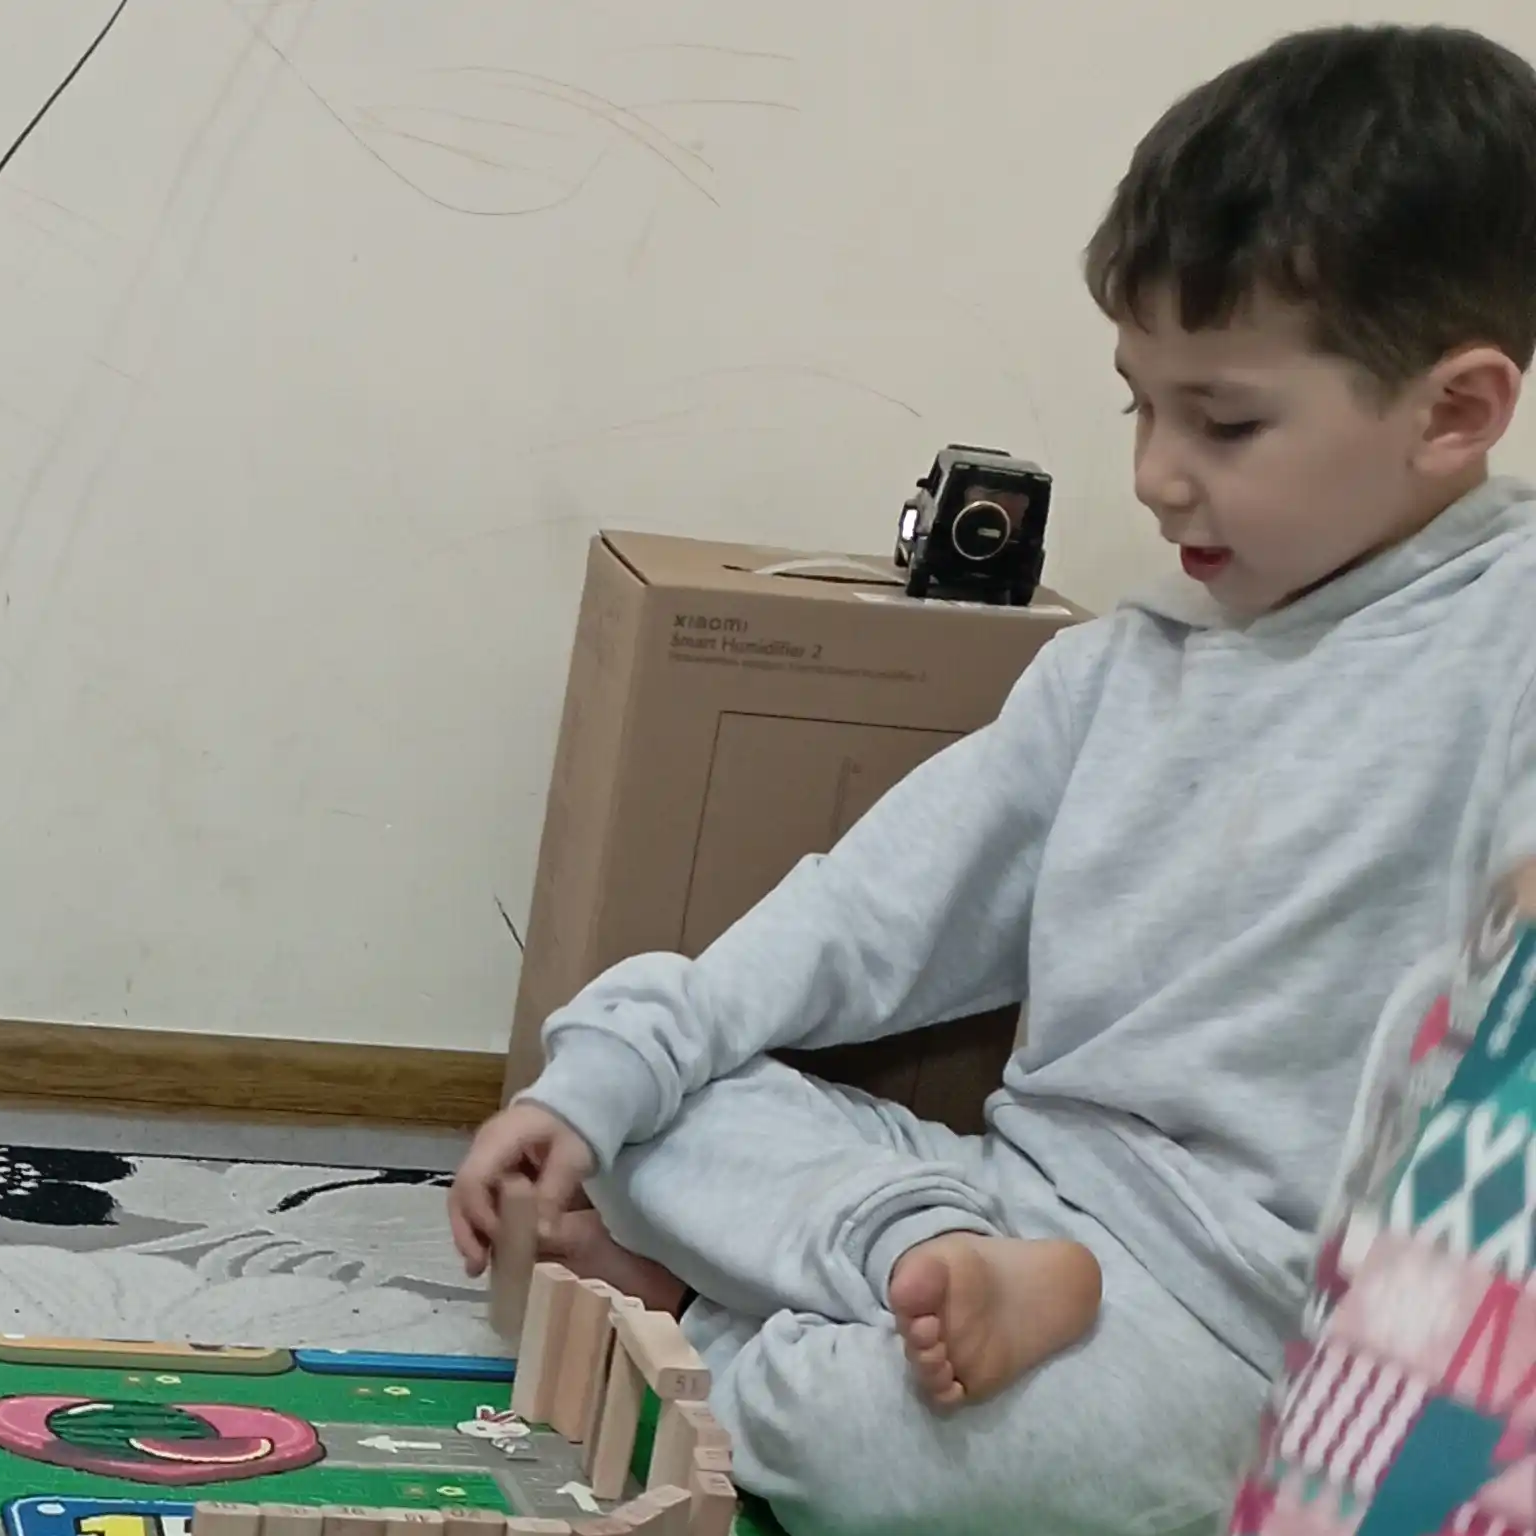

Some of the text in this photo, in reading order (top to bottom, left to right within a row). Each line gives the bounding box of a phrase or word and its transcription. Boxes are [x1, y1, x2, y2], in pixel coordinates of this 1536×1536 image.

[669, 633, 824, 660] Smart Humidifier 2
